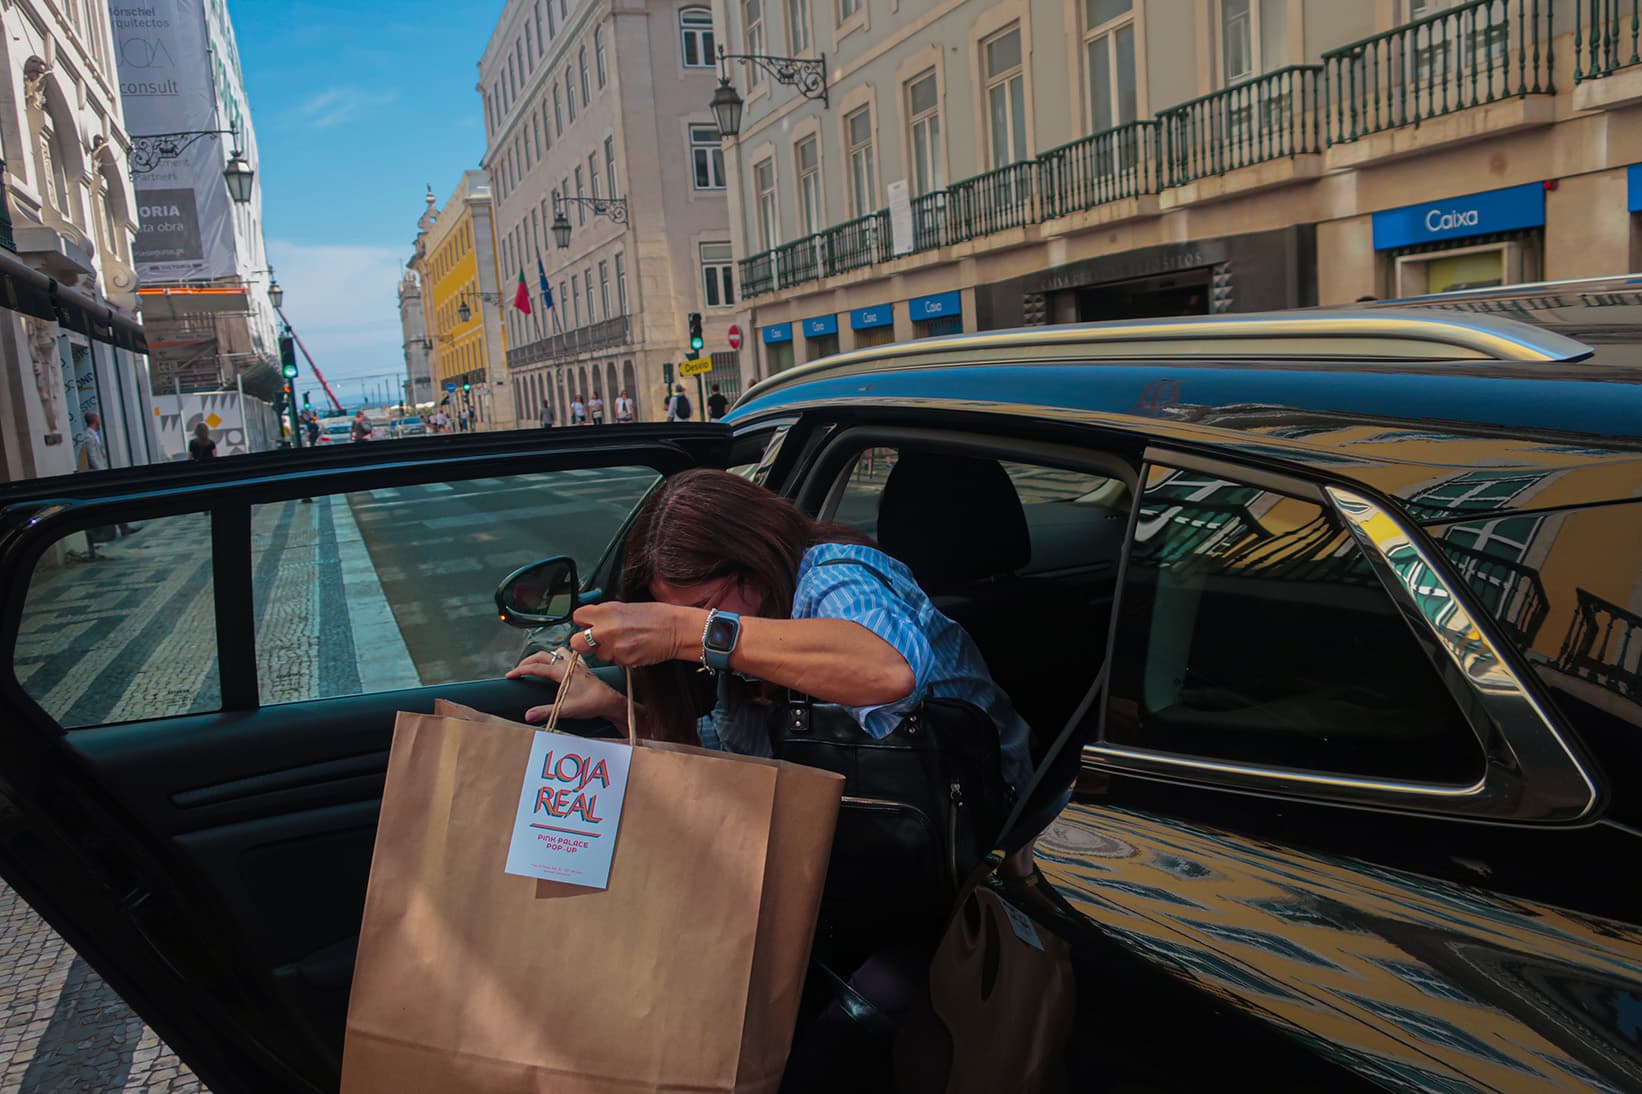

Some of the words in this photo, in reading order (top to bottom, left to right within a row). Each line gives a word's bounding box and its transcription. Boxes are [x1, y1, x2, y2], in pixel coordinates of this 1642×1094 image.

[120, 79, 178, 94] consult
[157, 222, 185, 233] obra
[1425, 209, 1478, 232] Caixa
[925, 300, 942, 313] Caixa
[862, 312, 877, 323] Caixa
[685, 361, 709, 373] Desvio
[541, 749, 611, 792] LOJA
[533, 786, 604, 824] REAL
[537, 834, 557, 843] PINK
[557, 836, 589, 849] PALACE
[546, 843, 578, 853] POP-UP
